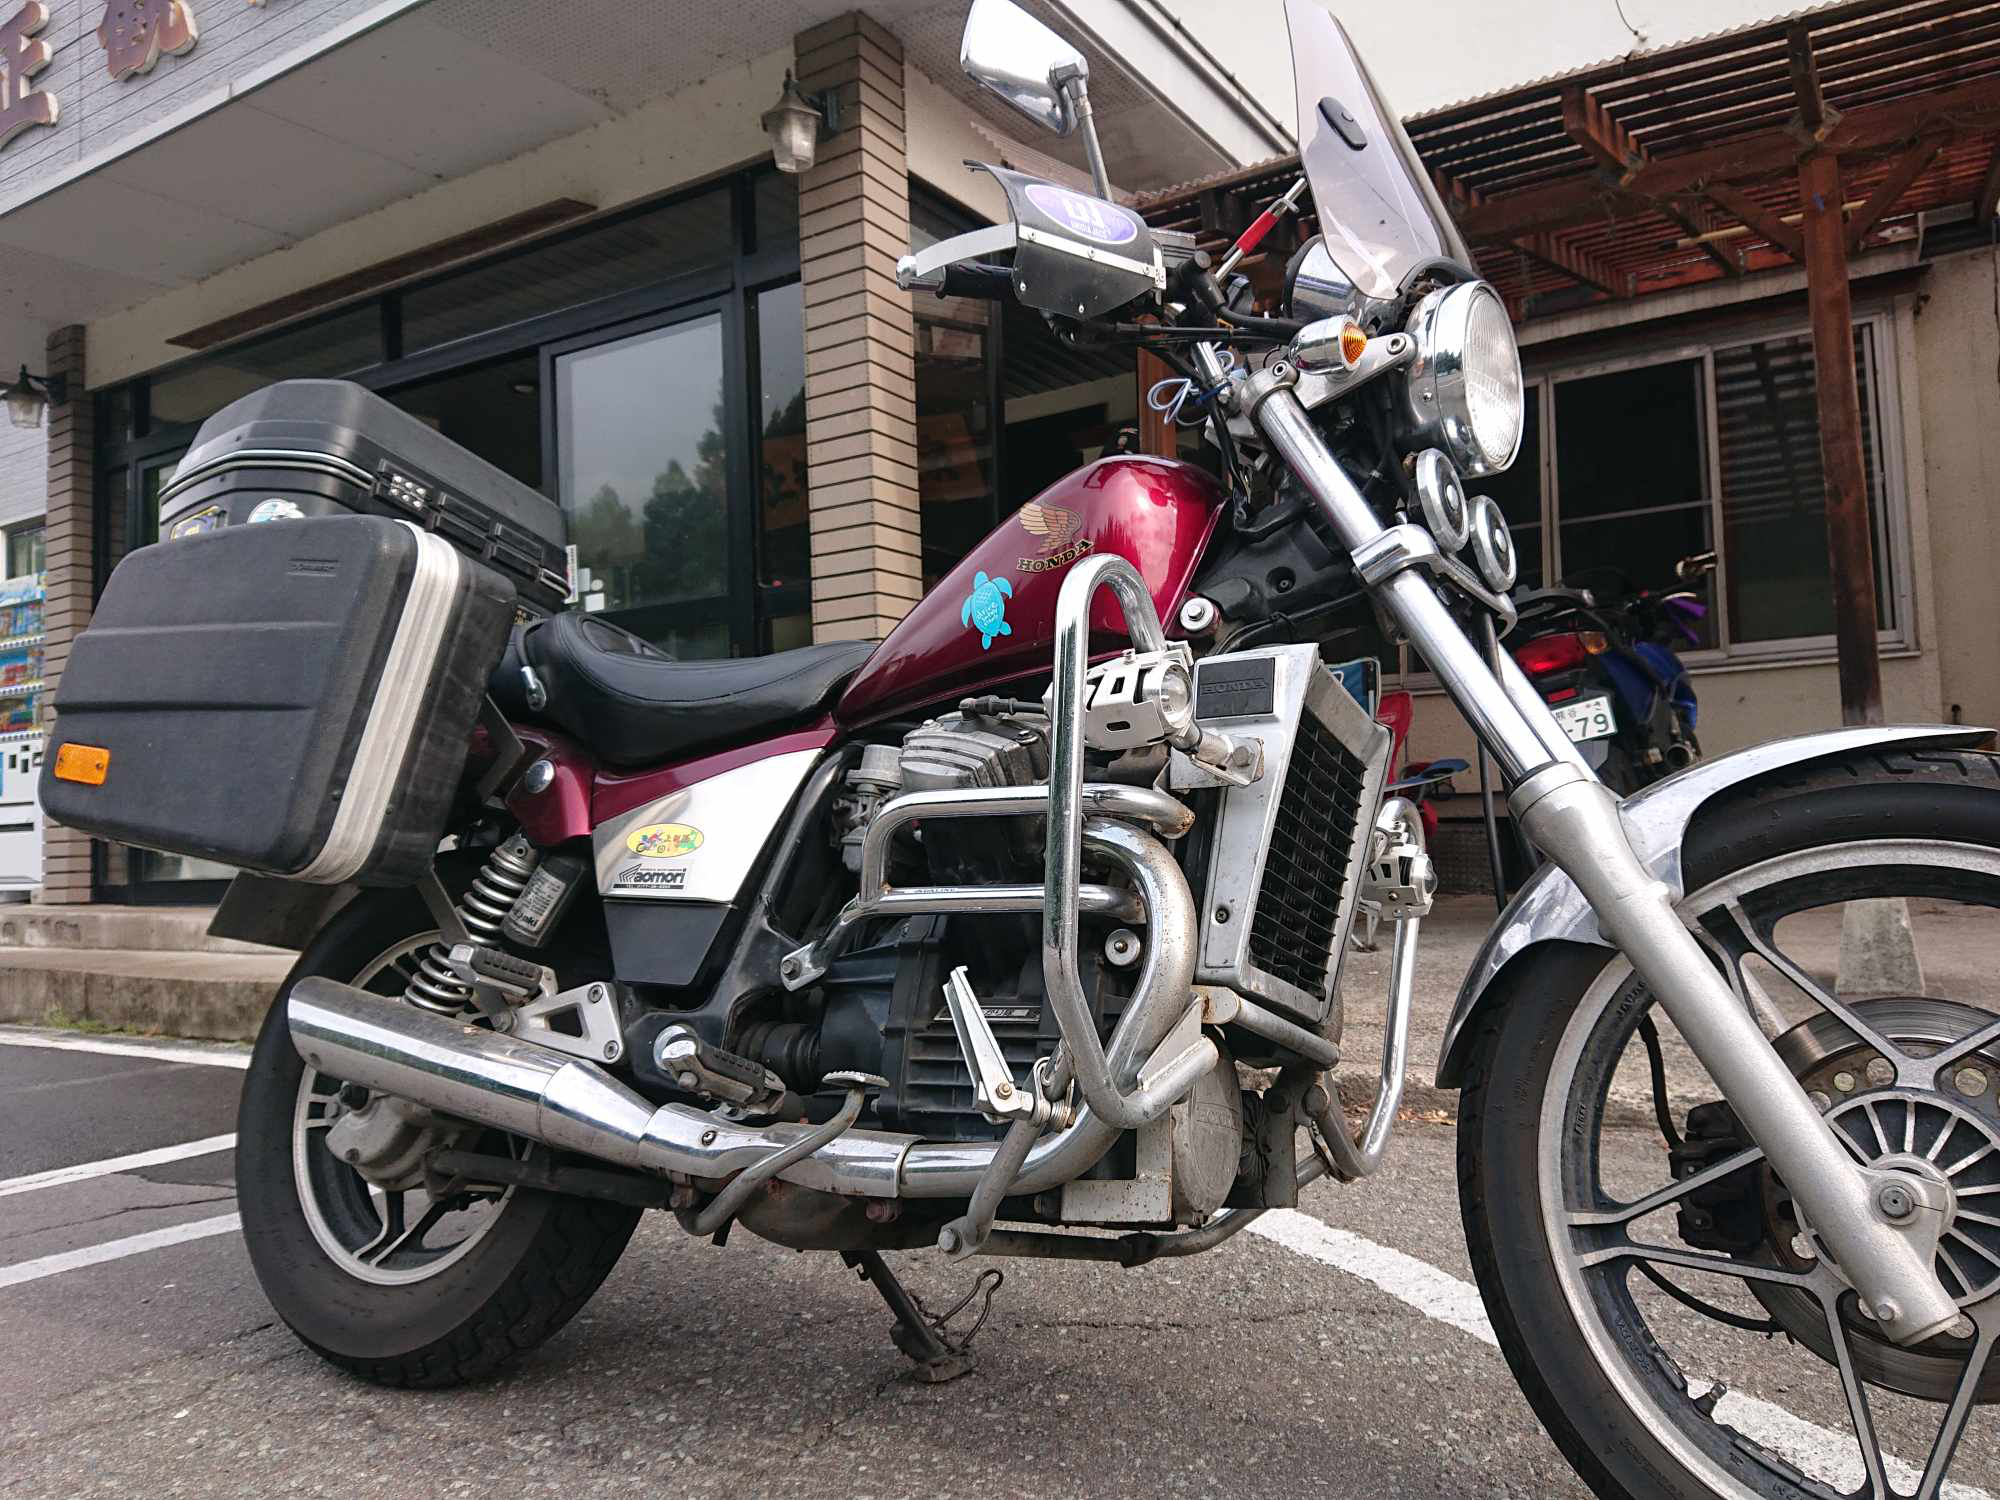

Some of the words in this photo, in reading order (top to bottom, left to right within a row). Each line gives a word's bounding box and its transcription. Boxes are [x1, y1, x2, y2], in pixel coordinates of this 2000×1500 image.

[1016, 538, 1095, 573] HONDA
[1567, 713, 1609, 737] -79
[633, 868, 687, 884] aomori
